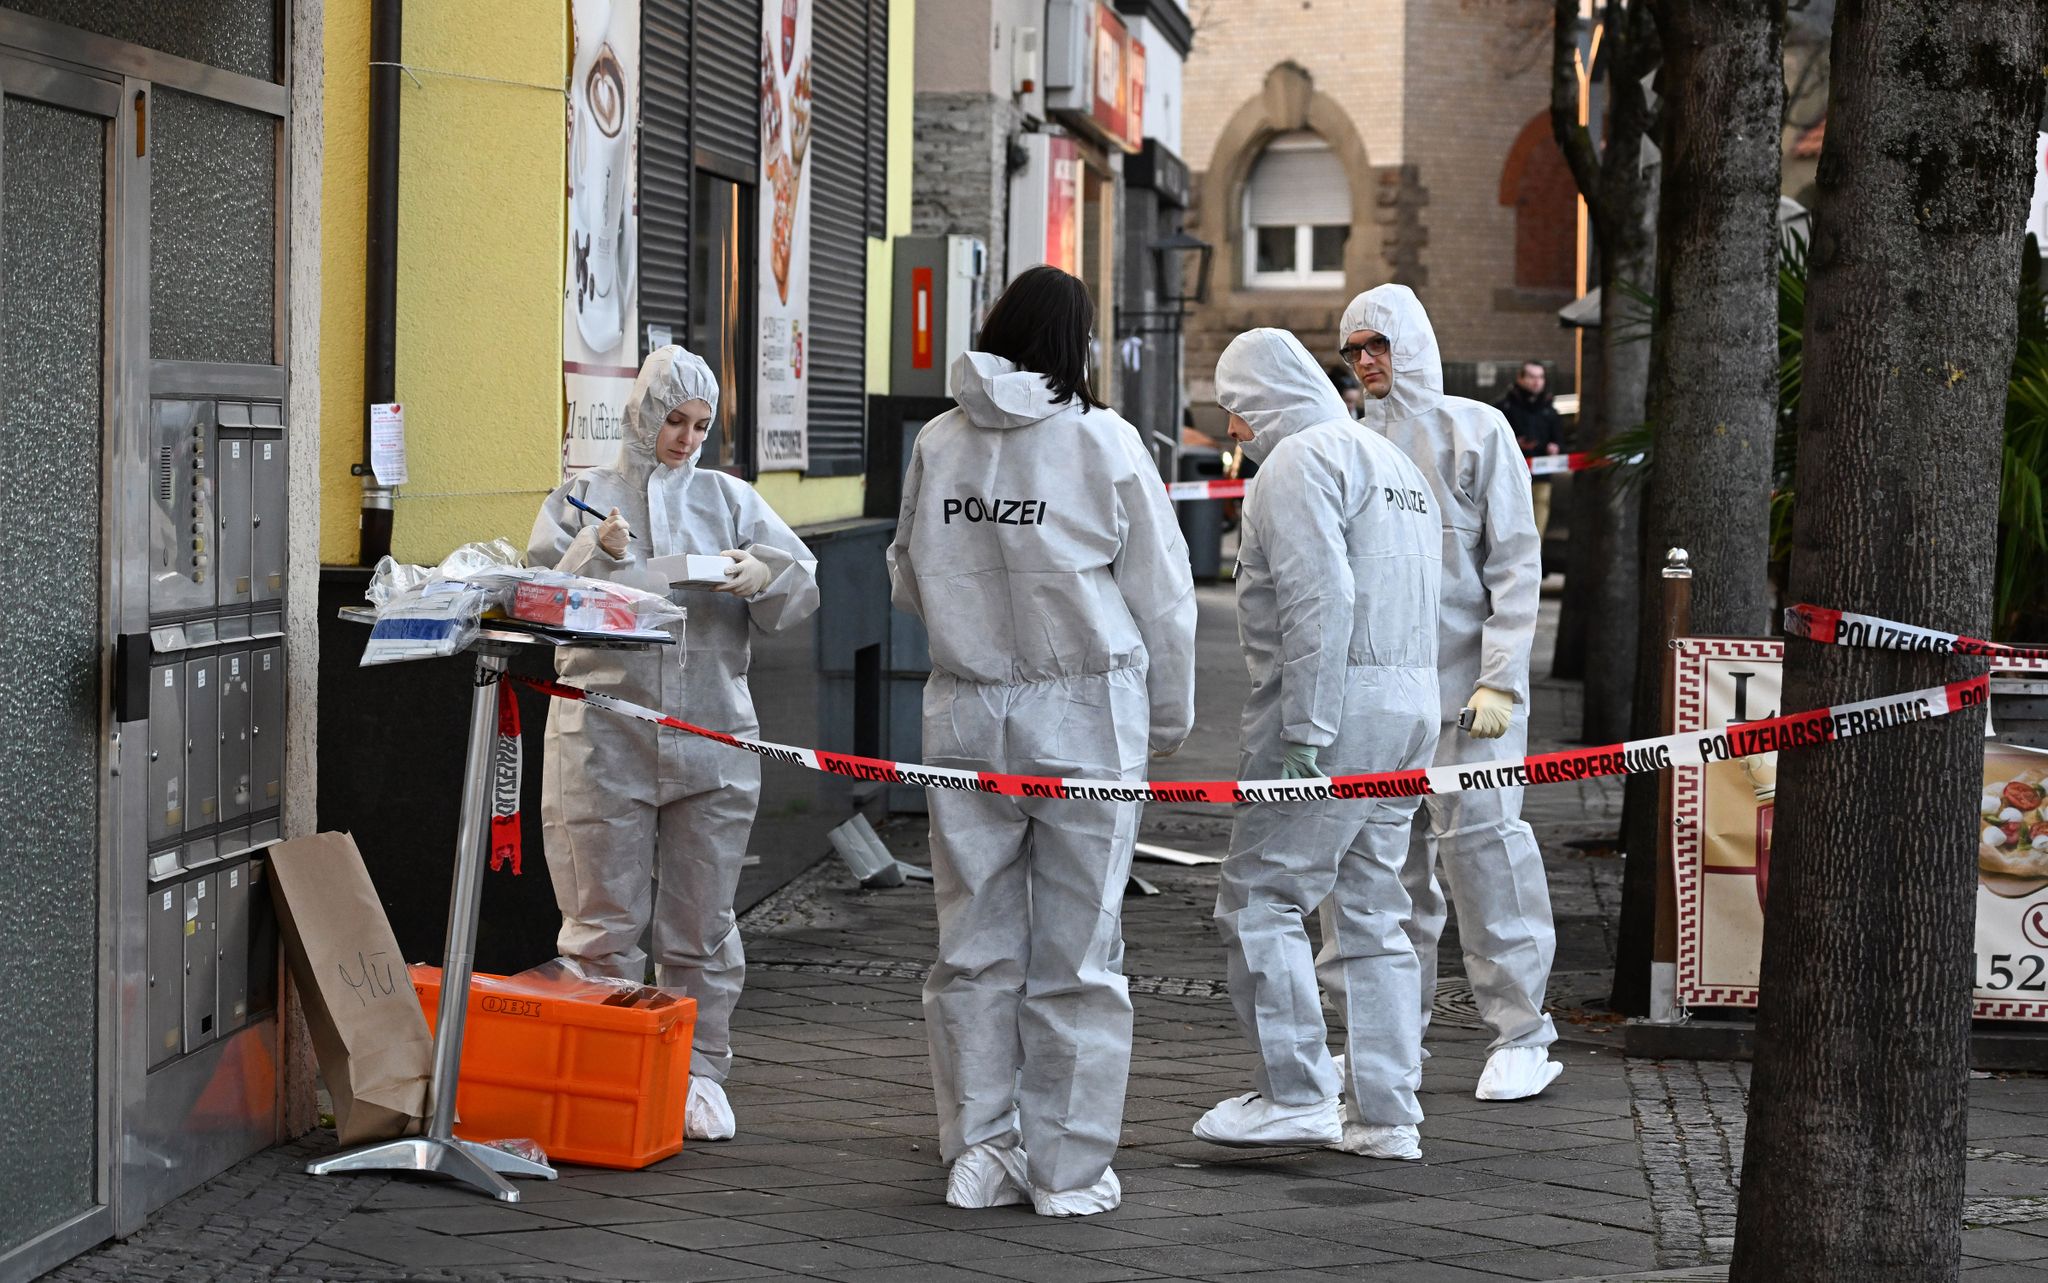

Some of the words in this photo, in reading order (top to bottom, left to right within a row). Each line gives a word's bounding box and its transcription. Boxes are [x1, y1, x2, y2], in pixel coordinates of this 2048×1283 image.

[943, 496, 1046, 525] POLIZEI
[1384, 487, 1428, 514] POLIZE
[1698, 697, 1932, 763] POLIZEIABSPERRUNG
[1458, 744, 1675, 790] POLIZEIABSPERRUNG
[481, 995, 542, 1018] OBI
